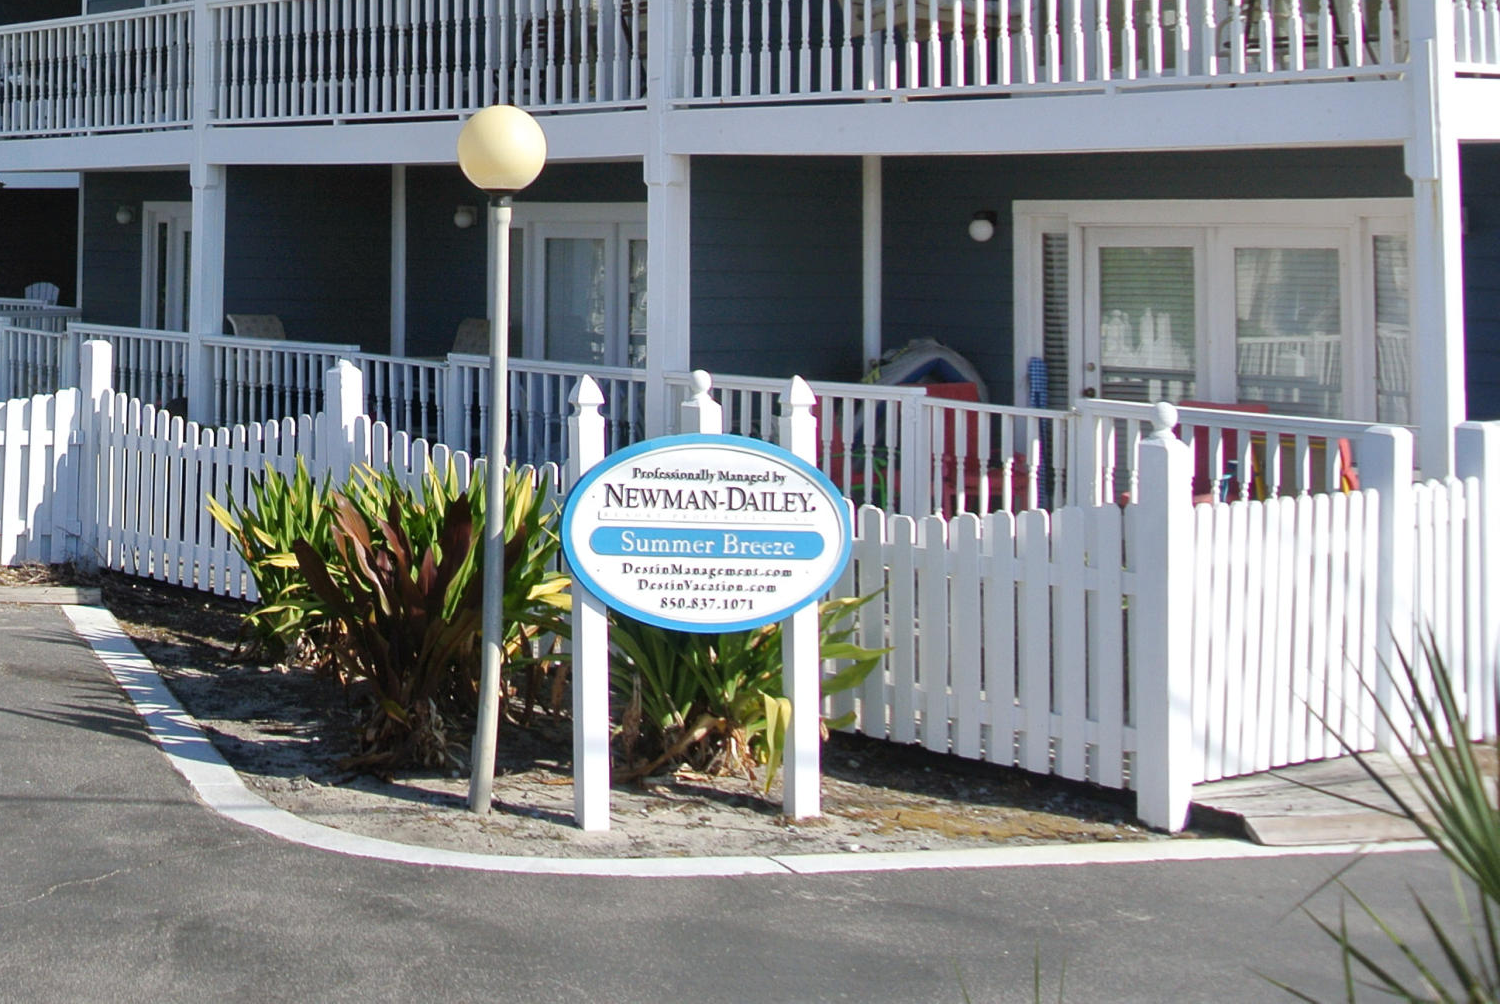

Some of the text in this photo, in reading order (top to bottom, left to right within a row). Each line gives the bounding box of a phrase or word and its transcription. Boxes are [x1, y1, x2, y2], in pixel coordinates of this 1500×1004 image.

[632, 467, 786, 486] Professionally Managed by
[621, 530, 796, 556] Summer Breeze
[622, 562, 792, 579] DestinManagement.com
[638, 579, 777, 593] DestinVacation.com
[660, 597, 754, 610] 850.837.1071
